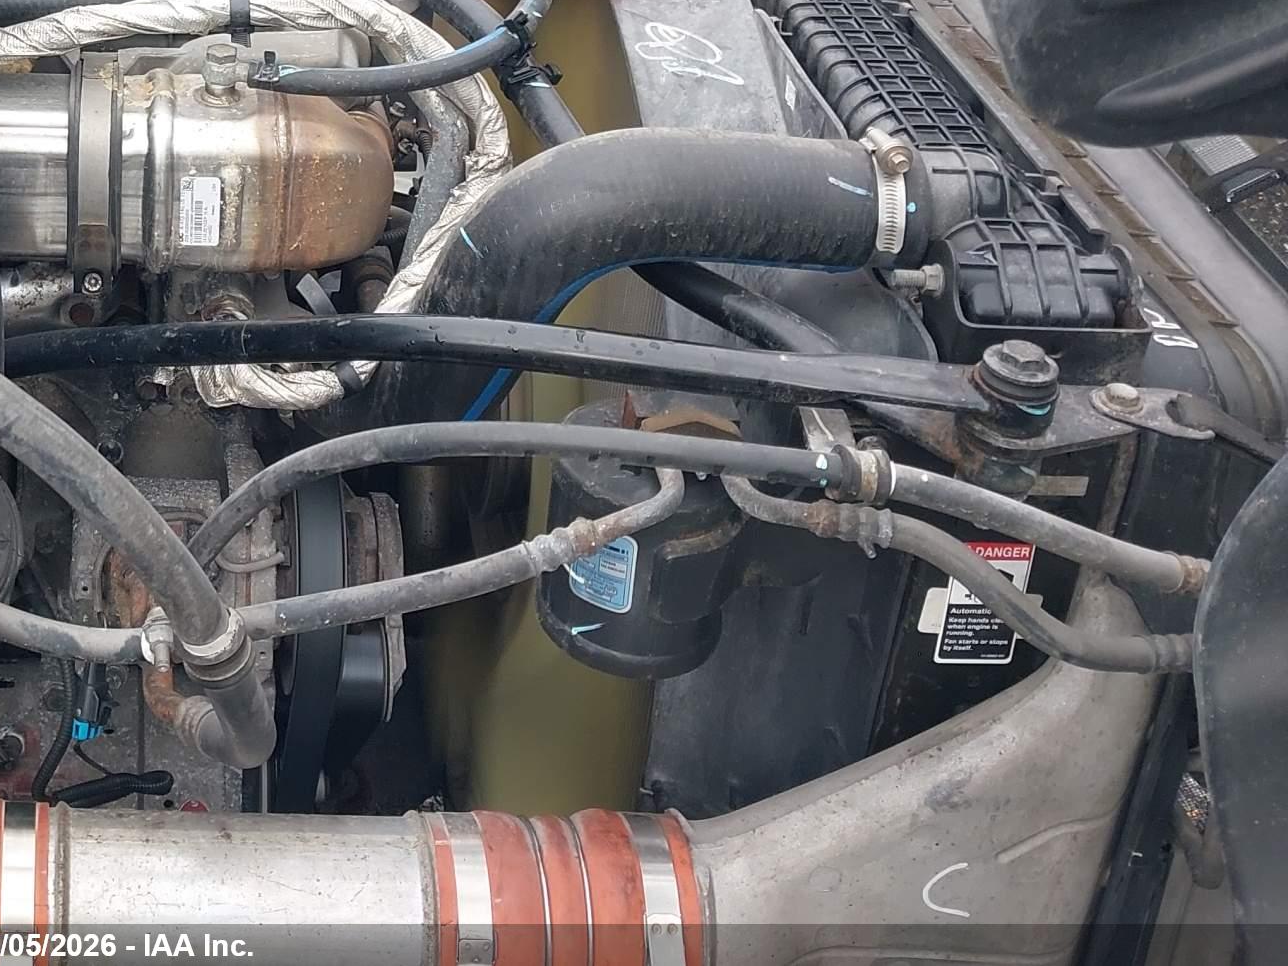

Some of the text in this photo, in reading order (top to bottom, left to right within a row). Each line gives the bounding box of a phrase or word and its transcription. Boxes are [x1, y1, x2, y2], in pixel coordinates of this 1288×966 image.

[975, 546, 1031, 558] DANGER
[950, 607, 992, 615] Automatic
[948, 616, 967, 624] Keep
